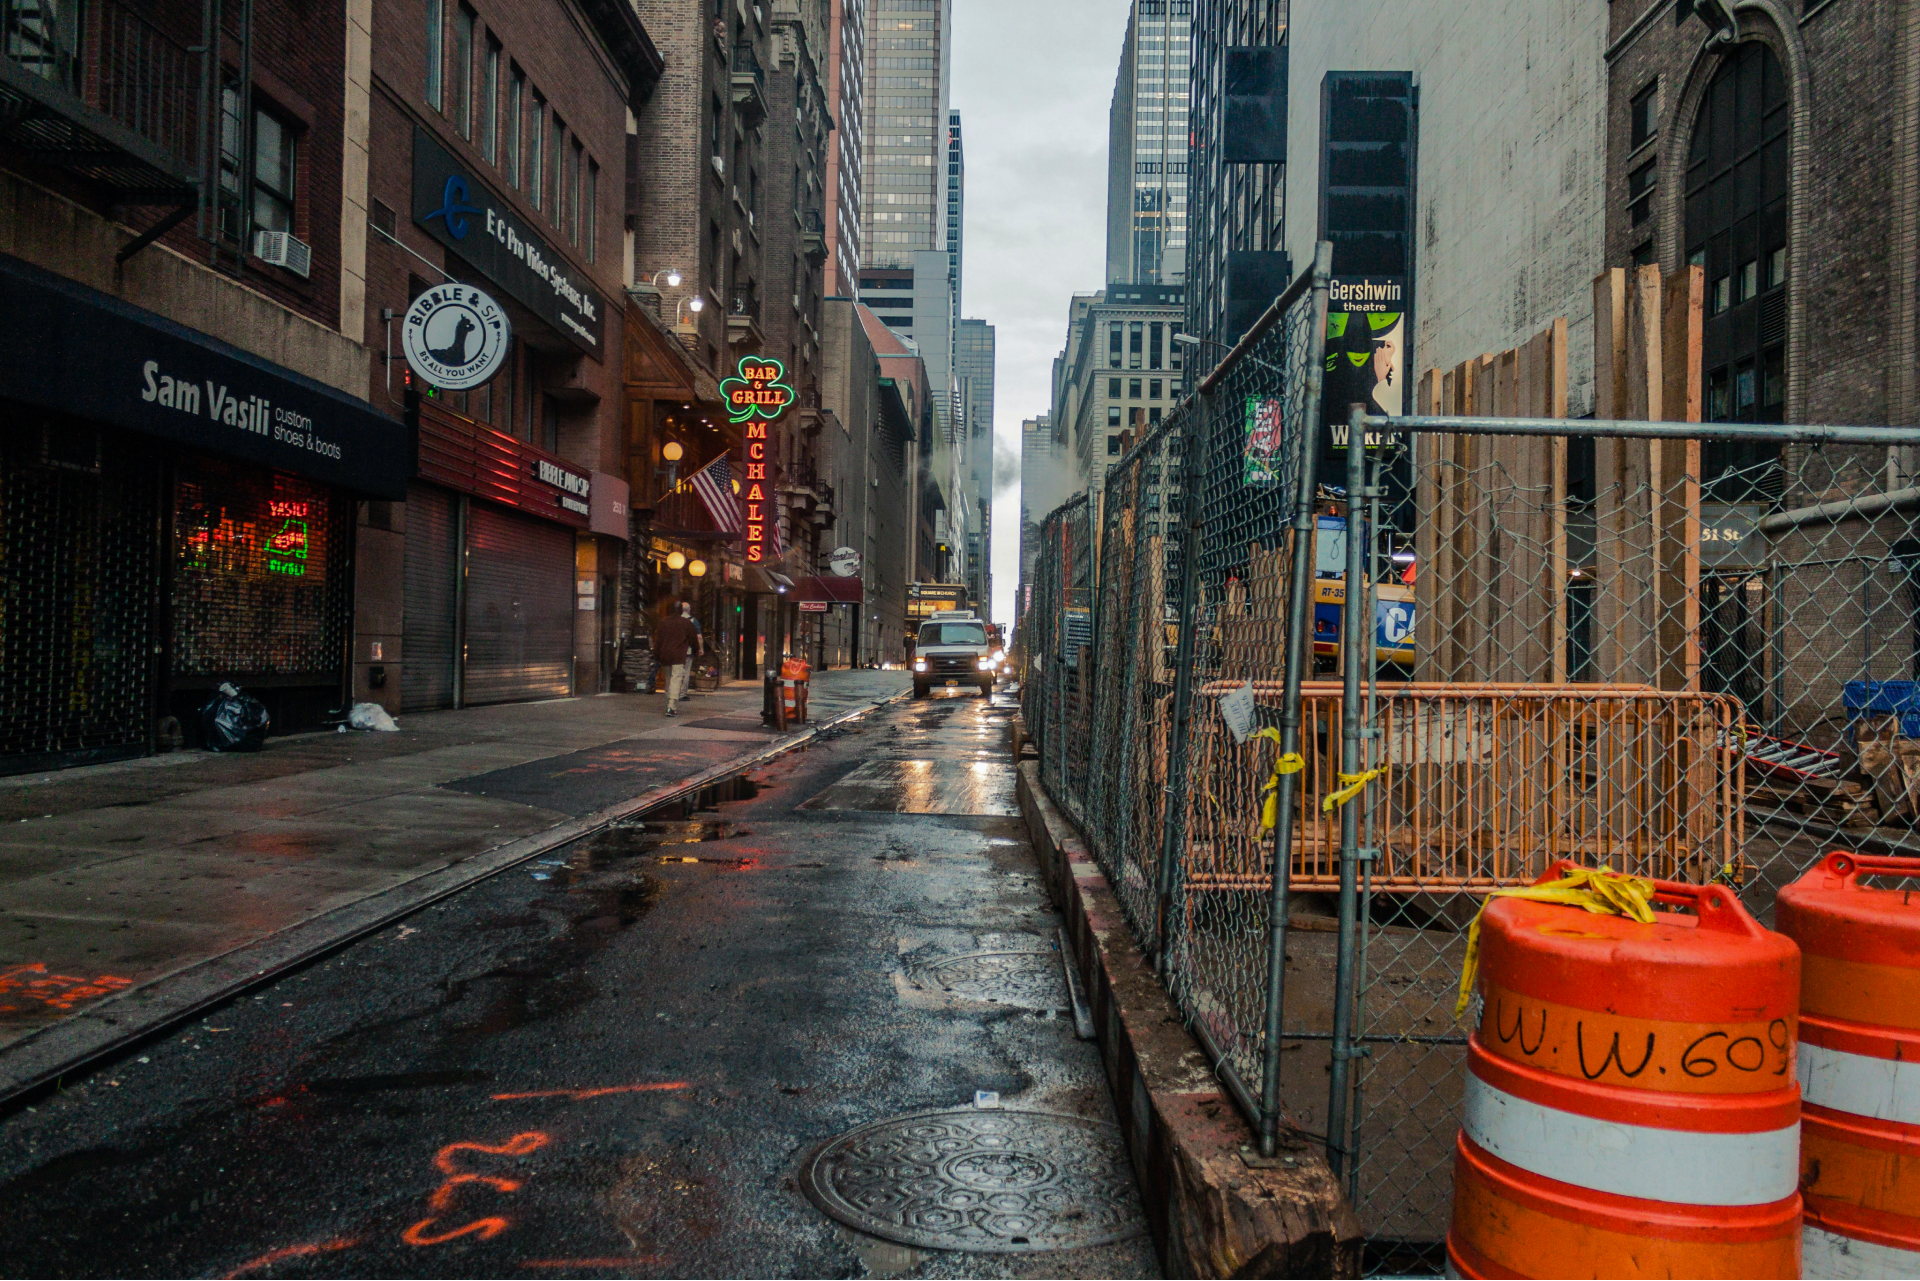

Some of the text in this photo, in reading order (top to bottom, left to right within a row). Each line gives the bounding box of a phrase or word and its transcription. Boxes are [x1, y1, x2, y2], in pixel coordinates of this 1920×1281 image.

[487, 208, 495, 236] E
[497, 219, 506, 244] C
[507, 227, 524, 260] Pro
[525, 242, 549, 281] Video
[583, 294, 597, 322] Inc.
[1329, 279, 1401, 300] Gershwin
[409, 287, 501, 329] BIBBLE & SIP
[1343, 302, 1387, 311] theatre
[419, 350, 490, 377] BS ALL YOU WANT
[744, 366, 778, 380] BAR
[753, 380, 763, 390] &
[142, 360, 270, 436] Sam Vasili
[731, 390, 786, 405] GRILL
[275, 407, 312, 431] custom
[274, 425, 341, 460] shoes & boots
[746, 422, 768, 563] MCHALES
[1701, 528, 1743, 542] 51 St.
[1321, 587, 1345, 598] RT-35
